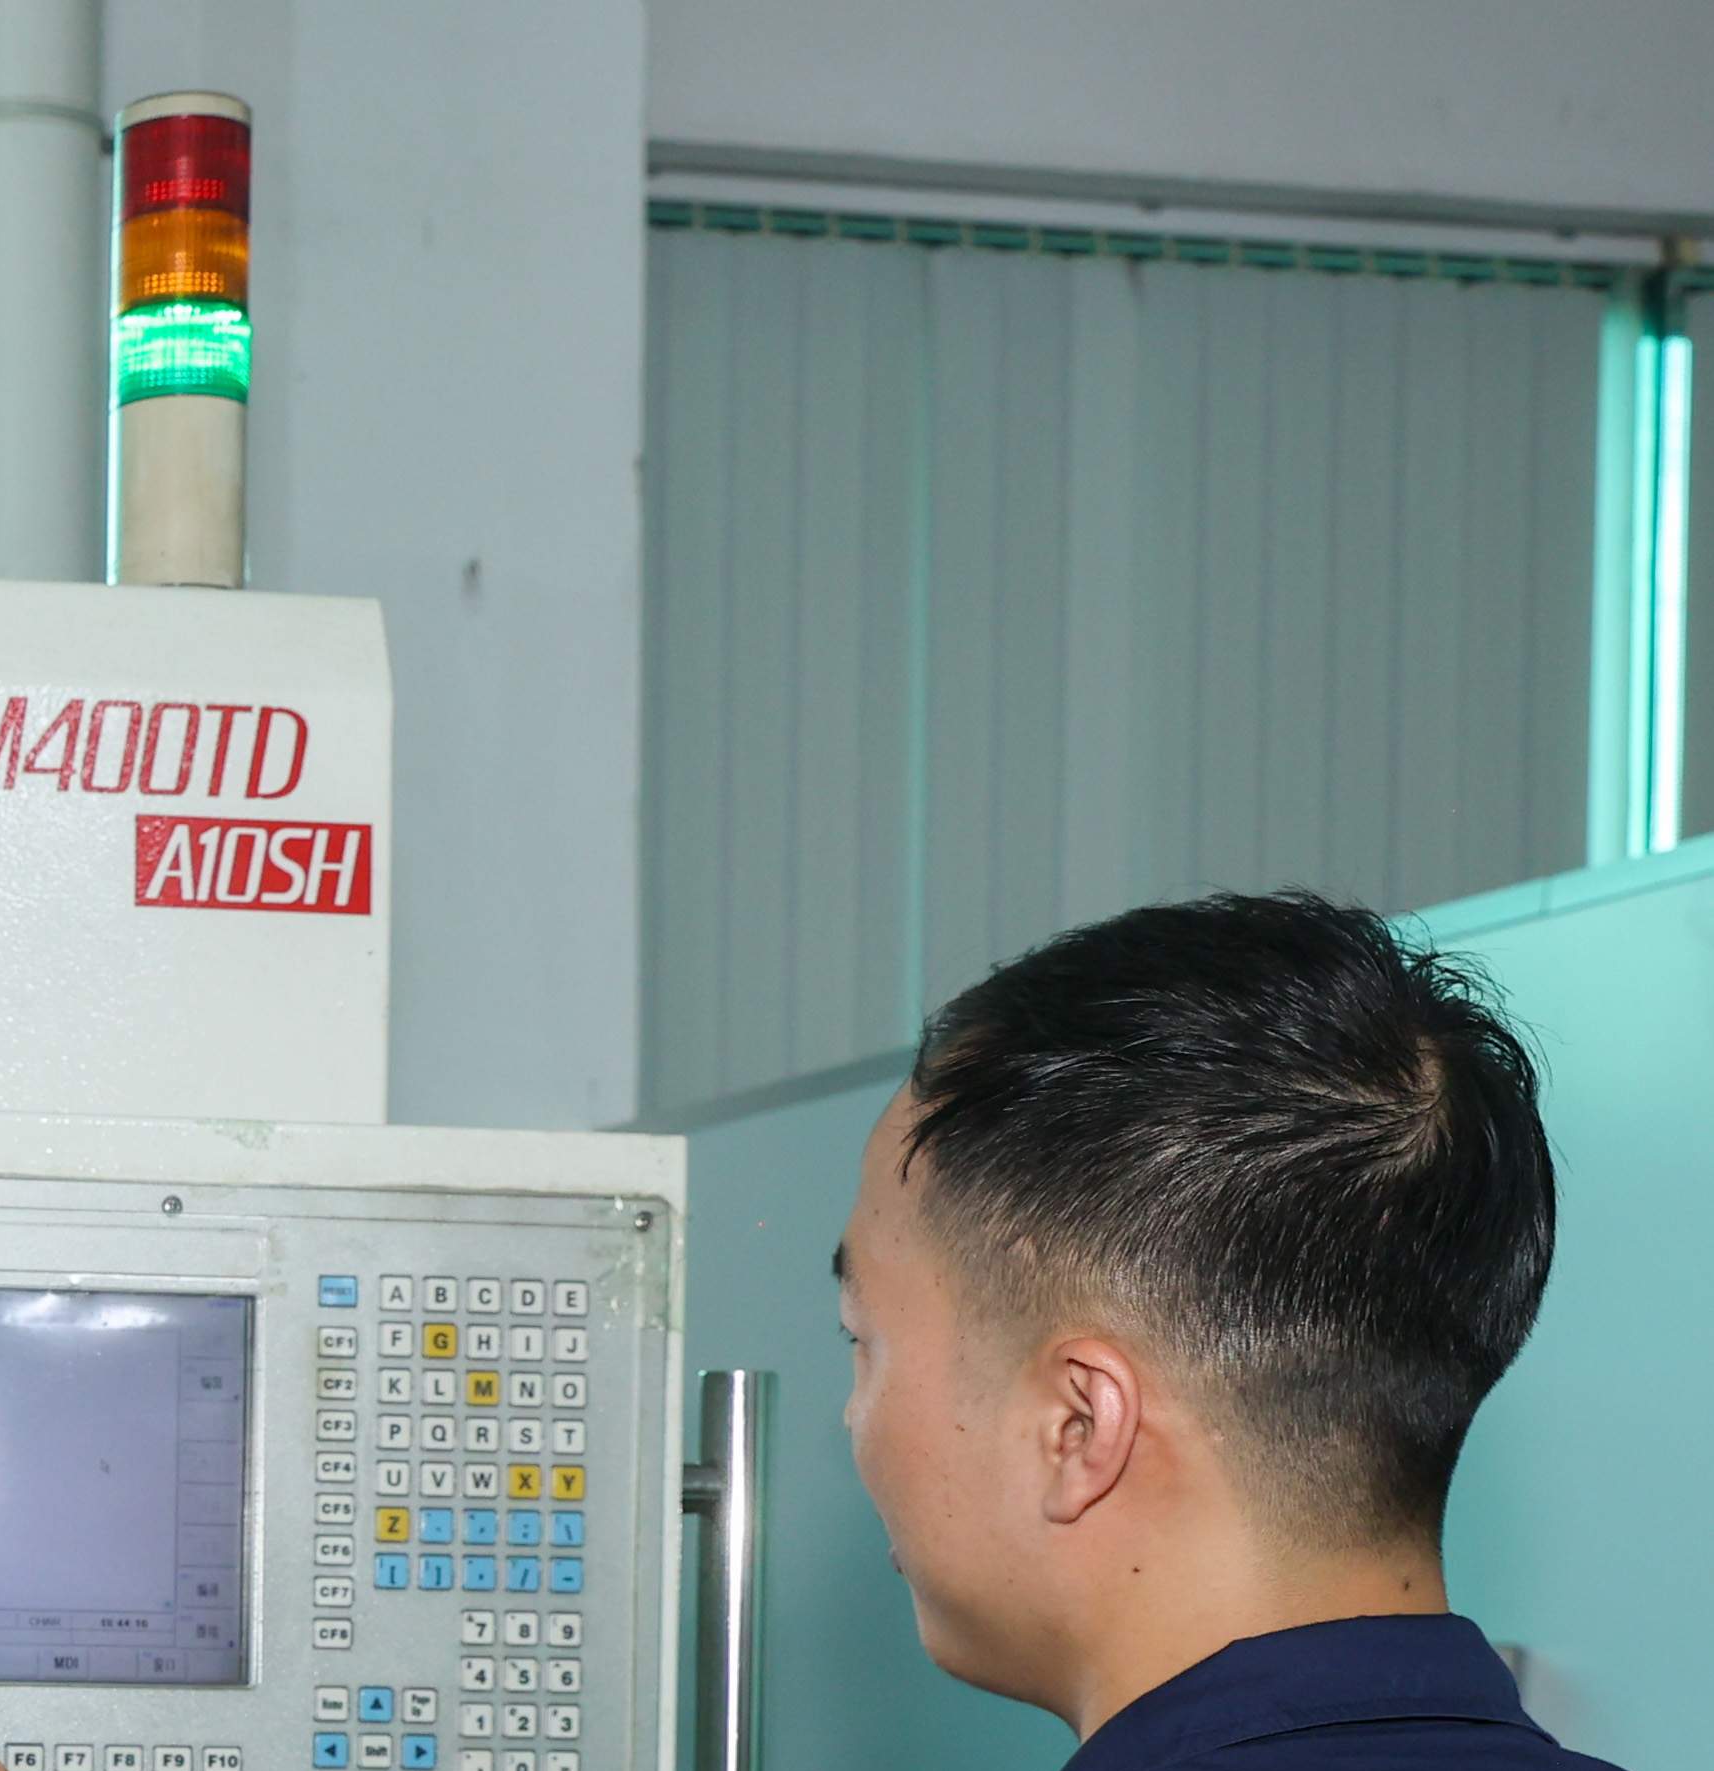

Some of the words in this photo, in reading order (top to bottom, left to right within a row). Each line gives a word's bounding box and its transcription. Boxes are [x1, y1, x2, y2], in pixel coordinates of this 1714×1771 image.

[144, 824, 362, 906] A10SH
[390, 1286, 403, 1302] A
[436, 1288, 447, 1302] B
[479, 1288, 491, 1304] C
[523, 1290, 535, 1306] D
[567, 1292, 576, 1307] E
[324, 1336, 353, 1347] CF1
[392, 1331, 402, 1346] F
[434, 1333, 448, 1349] G
[478, 1335, 490, 1350] H
[567, 1338, 576, 1353] J
[324, 1379, 352, 1390] CF2
[390, 1379, 401, 1394] K
[435, 1380, 444, 1395] L
[475, 1381, 492, 1396] M
[521, 1382, 534, 1397] N
[564, 1383, 577, 1398] O
[323, 1420, 351, 1432] CF3
[390, 1425, 401, 1440] P
[432, 1426, 446, 1442] Q
[477, 1427, 489, 1442] R
[520, 1428, 531, 1444] S
[565, 1430, 575, 1444] T
[322, 1461, 351, 1473] CF4
[387, 1471, 400, 1486] U
[432, 1472, 444, 1487] V
[473, 1473, 491, 1489] W
[519, 1474, 531, 1489] X
[563, 1475, 575, 1490] Y
[322, 1503, 351, 1514] CF5
[389, 1516, 398, 1532] Z
[320, 1545, 350, 1556] CF6
[320, 1587, 349, 1597] CF7
[476, 1624, 486, 1636] 7
[519, 1625, 530, 1638] 8
[563, 1625, 574, 1639] 9
[475, 1670, 486, 1683] 4
[519, 1671, 529, 1684] 5
[562, 1671, 572, 1685] 6
[477, 1717, 484, 1729] 1
[518, 1717, 529, 1731] 2
[562, 1717, 571, 1731] 3
[15, 1752, 36, 1767] F6
[65, 1753, 86, 1767] F7
[113, 1754, 135, 1767] F8
[163, 1754, 185, 1768] F9
[208, 1755, 237, 1769] F10
